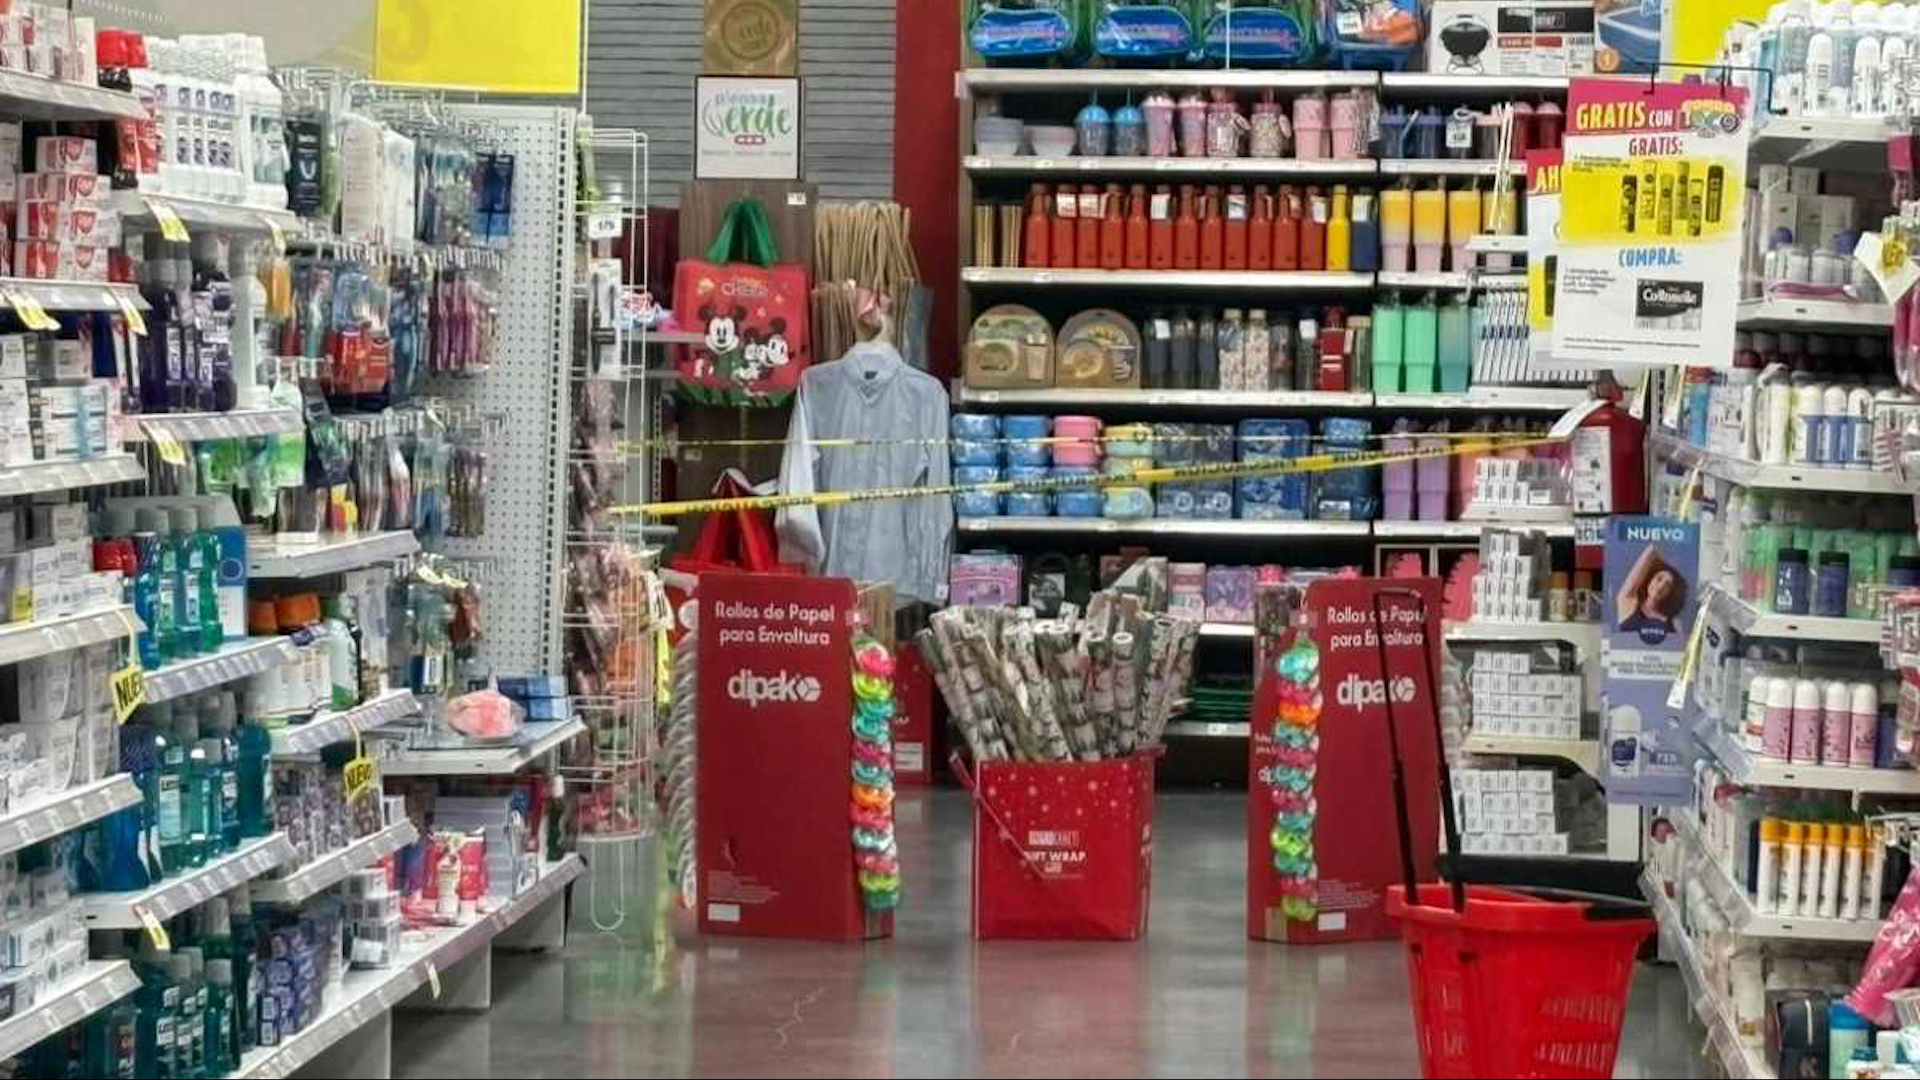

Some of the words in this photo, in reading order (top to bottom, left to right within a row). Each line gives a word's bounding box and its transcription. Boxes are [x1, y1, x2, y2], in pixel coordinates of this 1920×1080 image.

[1575, 101, 1646, 130] GRATIS
[1628, 136, 1684, 156] GRATIS:
[1618, 248, 1682, 268] COMPRA:
[1627, 527, 1684, 541] NUEVO
[763, 601, 785, 620] de
[789, 603, 834, 626] Papel
[1327, 606, 1366, 625] Rollos
[719, 629, 755, 647] para
[758, 625, 830, 645] Envoltura
[1330, 634, 1362, 652] para
[727, 669, 799, 707] dipak
[1049, 850, 1087, 862] WRAP
